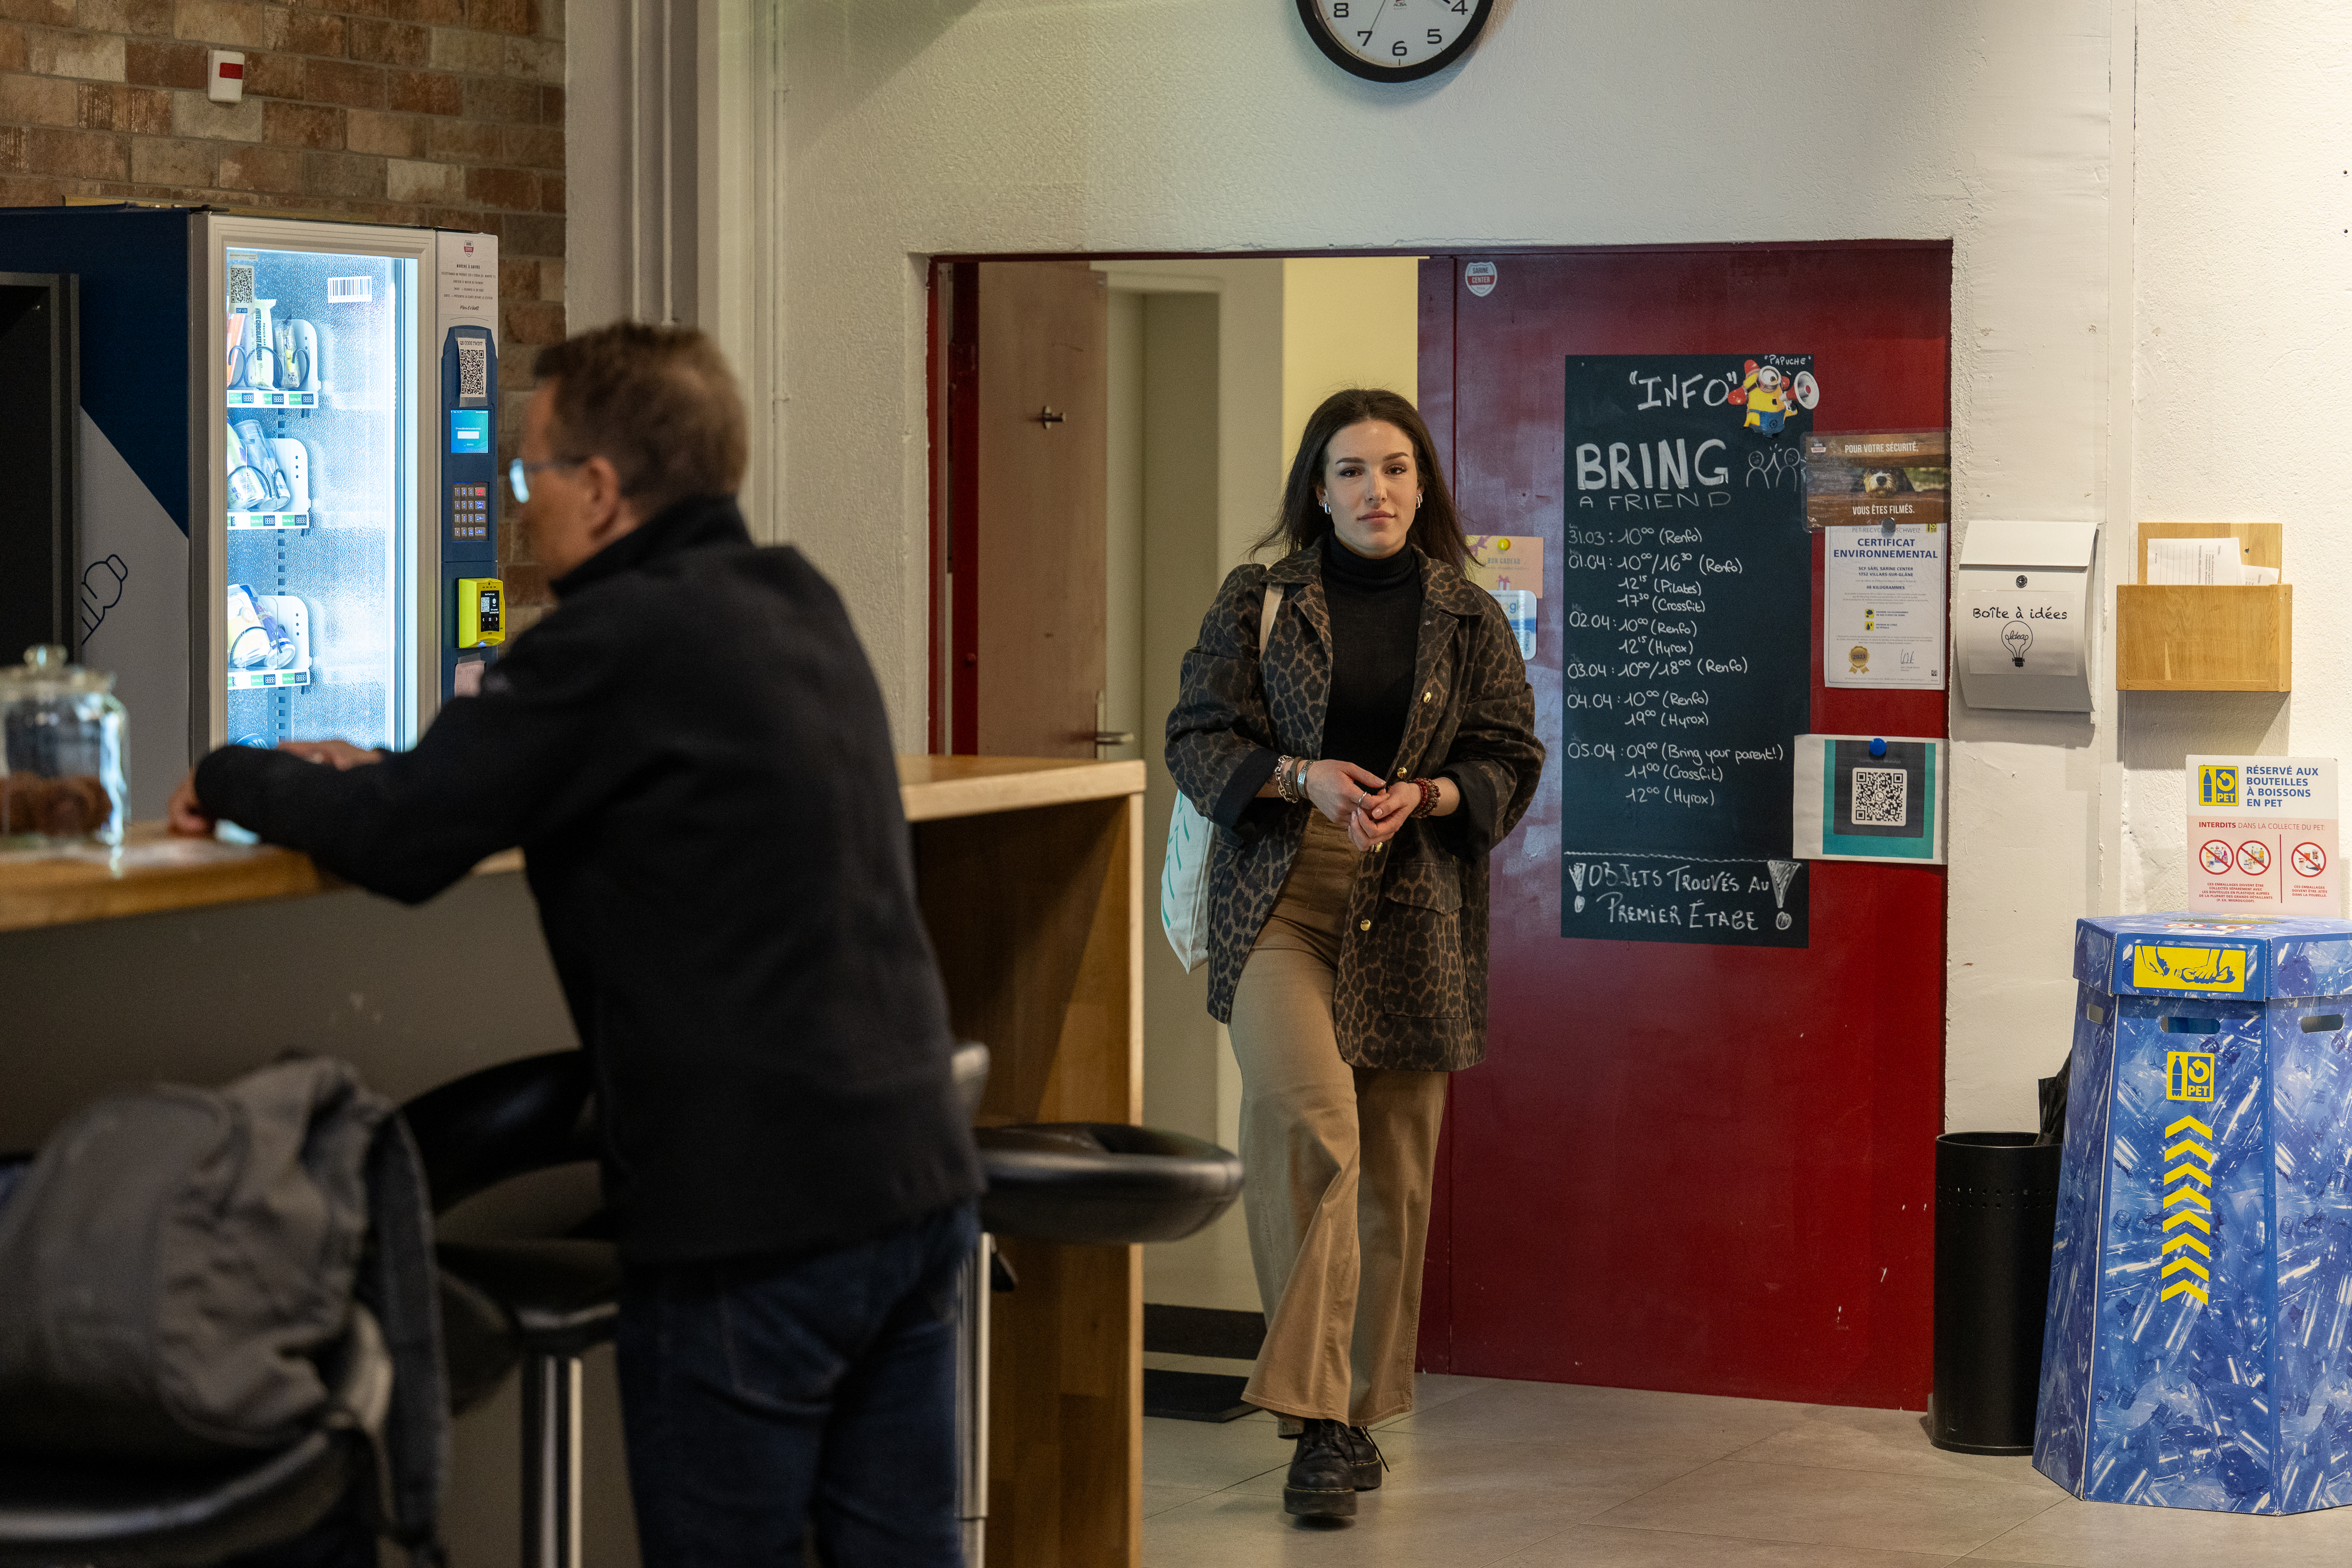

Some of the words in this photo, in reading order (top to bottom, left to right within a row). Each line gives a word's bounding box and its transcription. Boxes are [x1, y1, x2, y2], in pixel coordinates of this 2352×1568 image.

[1334, 2, 1348, 18] 8
[1451, 0, 1468, 15] 4
[1357, 31, 1372, 46] 7
[1427, 28, 1442, 45] 5
[1392, 41, 1407, 56] 6
[1845, 444, 1863, 453] POUR
[1863, 443, 1885, 453] VOTRE
[1886, 441, 1919, 452] SÉCURITÉ,
[1576, 438, 1729, 490] BRING
[1579, 495, 1594, 508] A
[1609, 492, 1732, 511] FRIEND
[1852, 506, 1870, 515] VOUS
[1871, 504, 1888, 514] ÊTES
[1889, 503, 1915, 514] FILMÉS.
[1659, 527, 1702, 546] (Renfo)
[1857, 538, 1915, 547] CERTIFICAT
[1833, 549, 1938, 559] ENVIRONNEMENTAL
[1699, 554, 1743, 575] (Renfo)
[1653, 577, 1702, 596] (Pilates)
[1652, 595, 1706, 613] (Crossfit)
[1973, 606, 2010, 618] Boîte
[2016, 606, 2023, 618] à
[2030, 606, 2068, 619] idées
[1651, 620, 1698, 637] (Renfo)
[1648, 638, 1693, 658] (Hyrox)
[1697, 656, 1748, 675] (Renfo)
[1662, 690, 1709, 708] (Renfo)
[1661, 711, 1709, 728] (Hyrox)
[1662, 741, 1703, 766] (Bring
[1705, 749, 1730, 764] your
[1735, 744, 1784, 765] parent!)
[1663, 764, 1723, 783] (Crossfit)
[2246, 765, 2292, 775] RÉSERVÉ
[2296, 767, 2318, 776] AUX
[2246, 777, 2308, 786] BOUTEILLES
[1665, 785, 1715, 808] (Hyrox)
[2217, 793, 2235, 802] PET
[2247, 787, 2254, 796] À
[2258, 788, 2311, 797] BOISSONS
[2264, 799, 2283, 807] PET
[2188, 1085, 2210, 1096] PET
